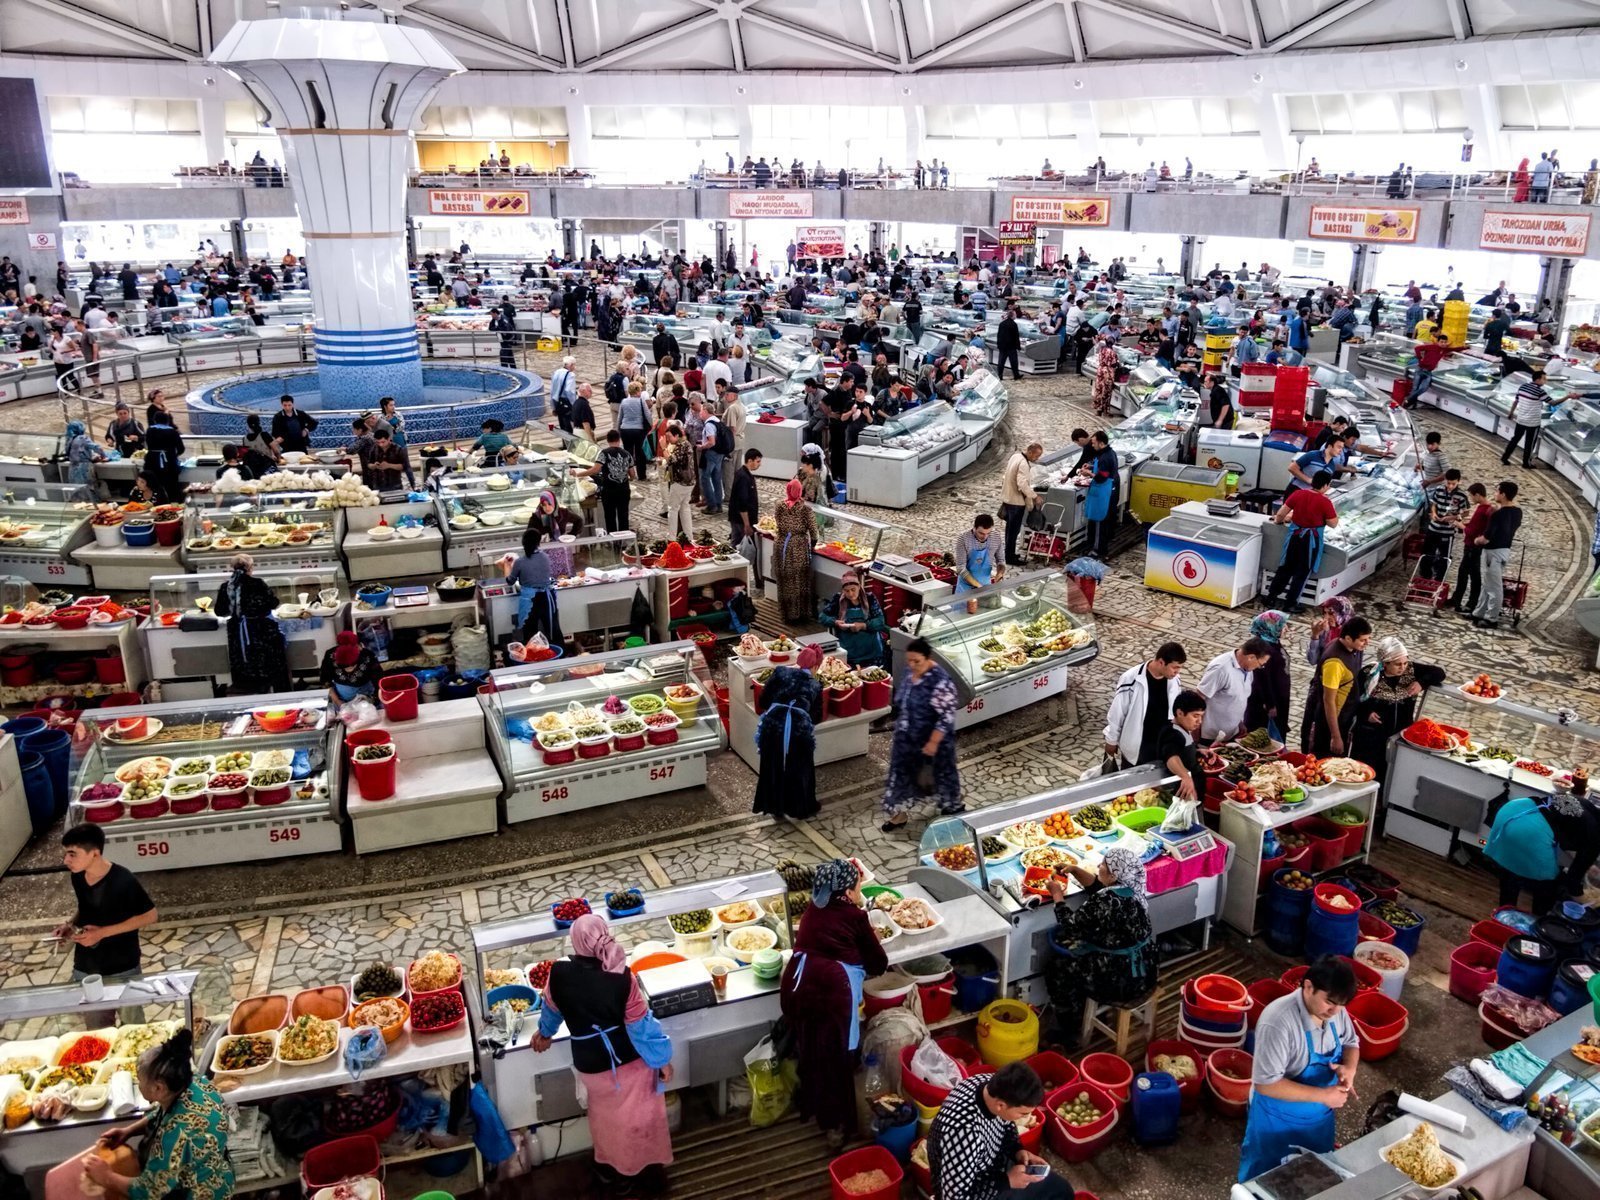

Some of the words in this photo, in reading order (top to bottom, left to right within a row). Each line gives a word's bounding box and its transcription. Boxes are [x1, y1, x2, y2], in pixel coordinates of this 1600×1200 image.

[433, 192, 450, 201] MOL
[442, 203, 474, 212] RASTASI
[1053, 203, 1062, 211] VA
[1016, 211, 1031, 220] QAZI
[1032, 212, 1060, 221] RASTASI
[1314, 211, 1336, 221] TOVUQ
[1323, 223, 1352, 234] RASTASI
[1501, 218, 1541, 231] TAROZIDAN
[1517, 234, 1545, 246] UYATGA
[47, 566, 65, 575] 533
[1033, 675, 1049, 690] 545
[967, 698, 984, 714] 546
[650, 765, 675, 781] 547
[542, 786, 569, 803] 548
[269, 827, 301, 843] 549
[137, 841, 170, 857] 550
